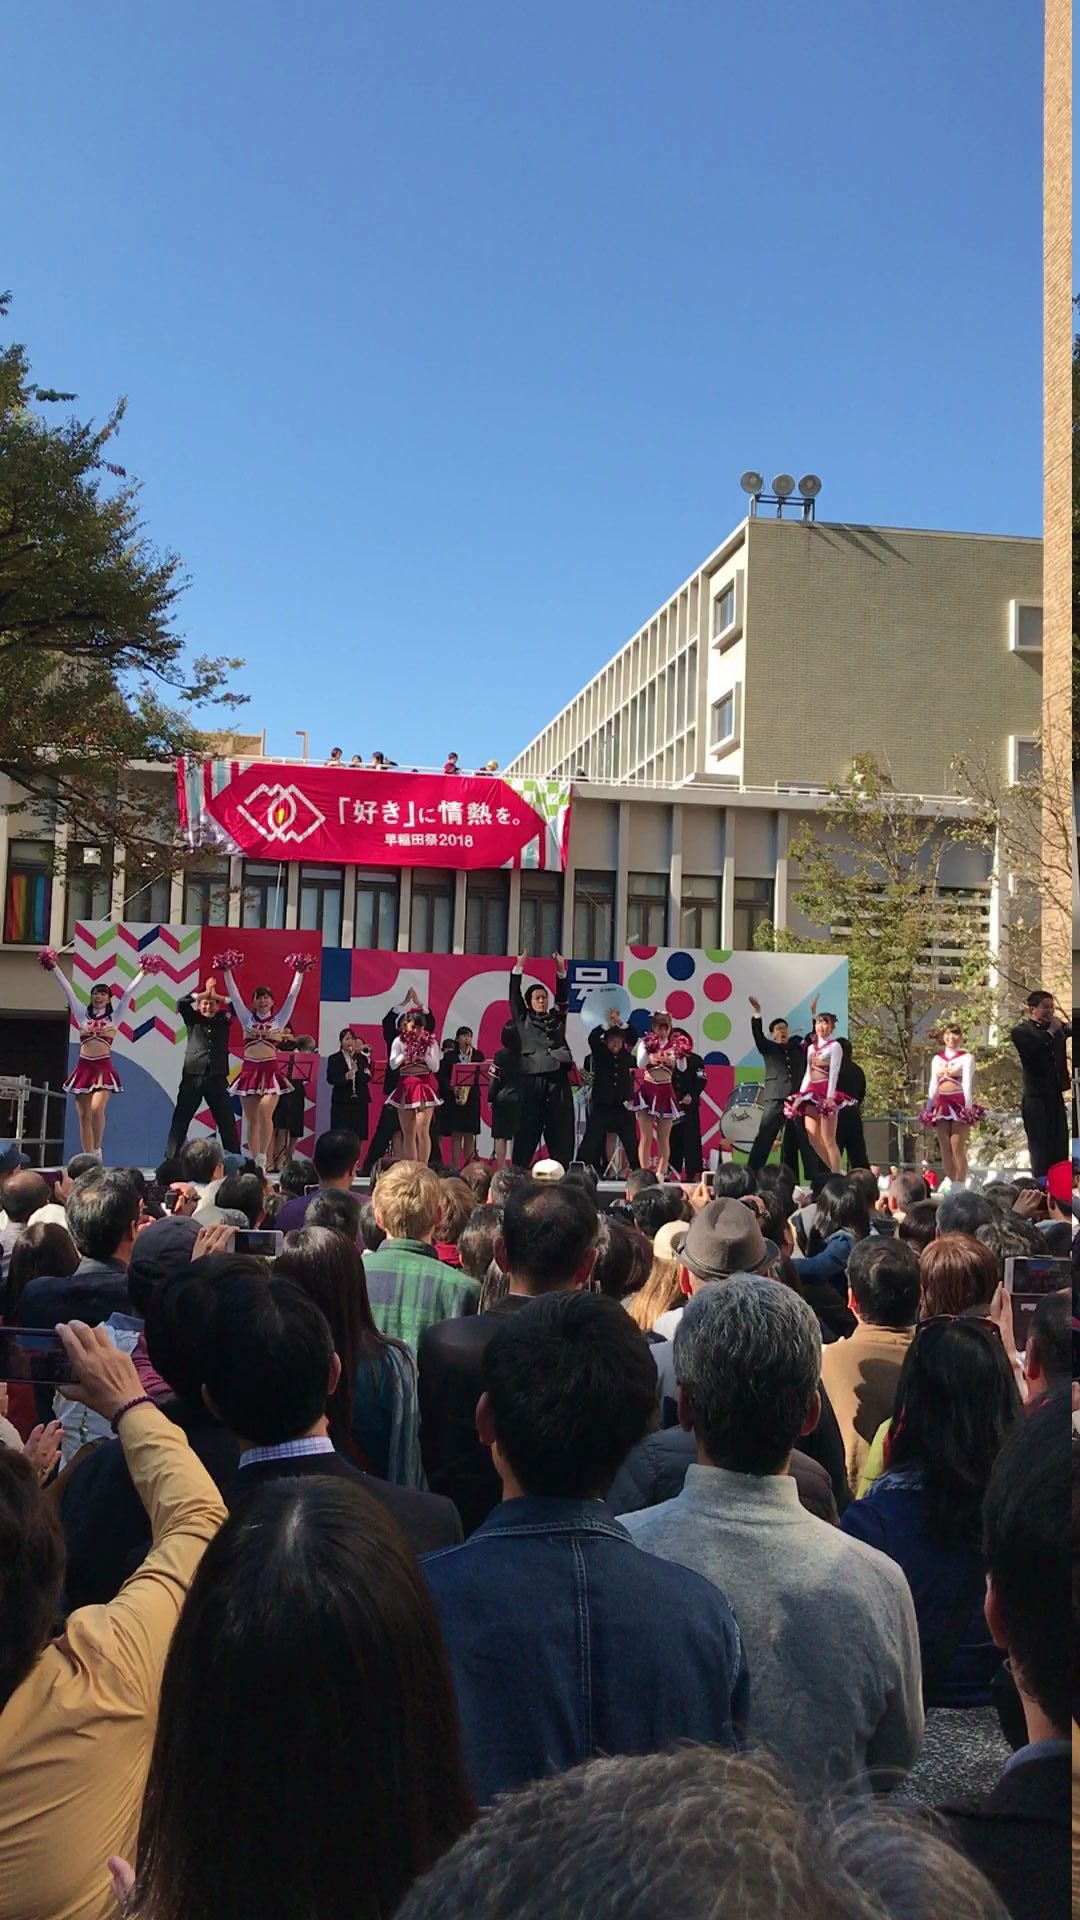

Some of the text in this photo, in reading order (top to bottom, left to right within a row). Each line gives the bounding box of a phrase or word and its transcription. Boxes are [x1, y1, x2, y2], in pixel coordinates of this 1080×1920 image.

[338, 796, 520, 828] 「好き」に情熱を。
[384, 833, 473, 848] 早稲田祭2018
